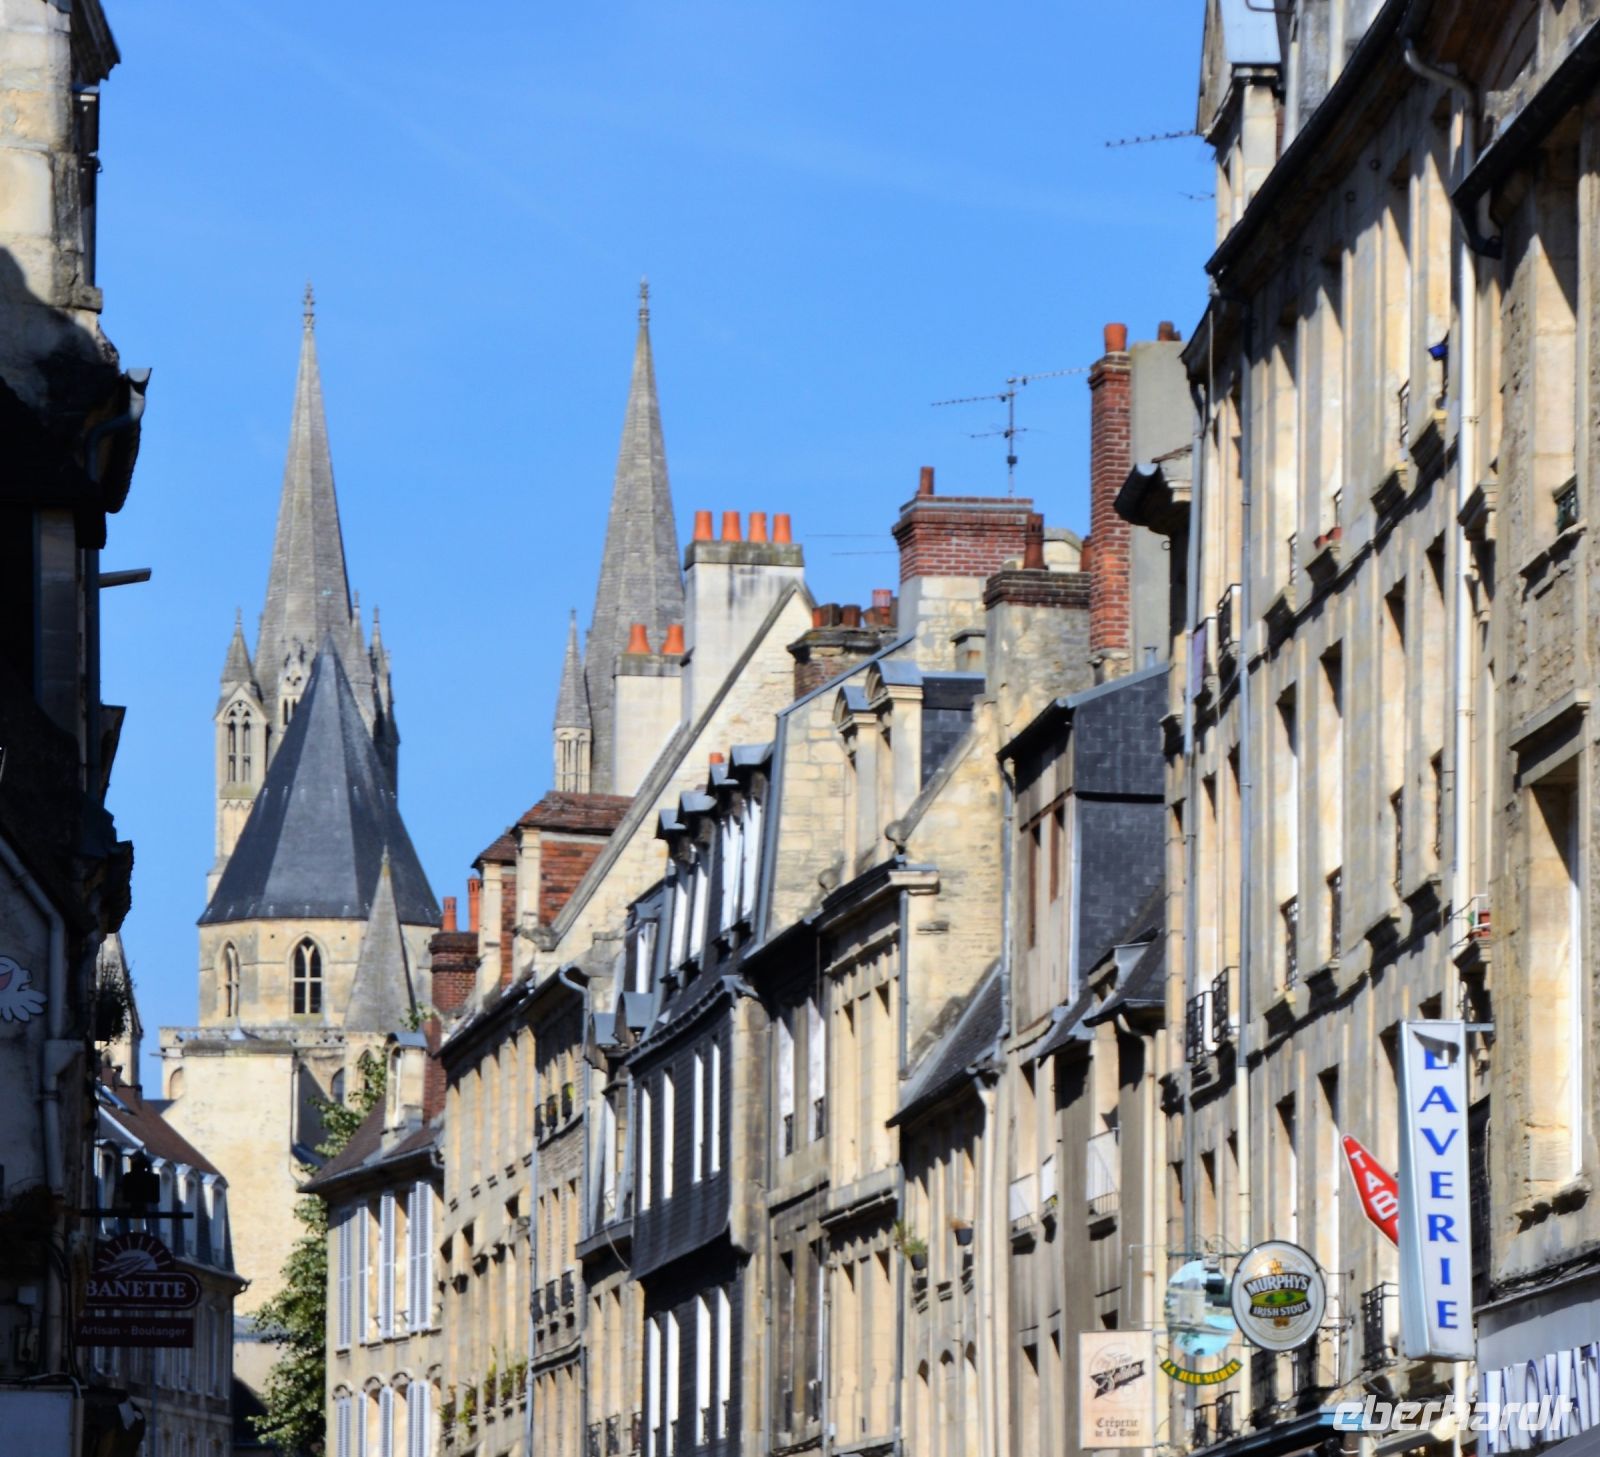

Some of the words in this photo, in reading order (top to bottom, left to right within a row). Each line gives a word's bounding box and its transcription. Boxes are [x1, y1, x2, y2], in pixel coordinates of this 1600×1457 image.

[1350, 1150, 1399, 1233] TAB
[1418, 1042, 1459, 1329] LAVERIE
[85, 1280, 187, 1298] BANETTE
[1253, 1305, 1280, 1317] IRISH
[1281, 1302, 1308, 1316] STOUT
[81, 1325, 120, 1335] Artisan
[131, 1325, 187, 1338] Boulanger
